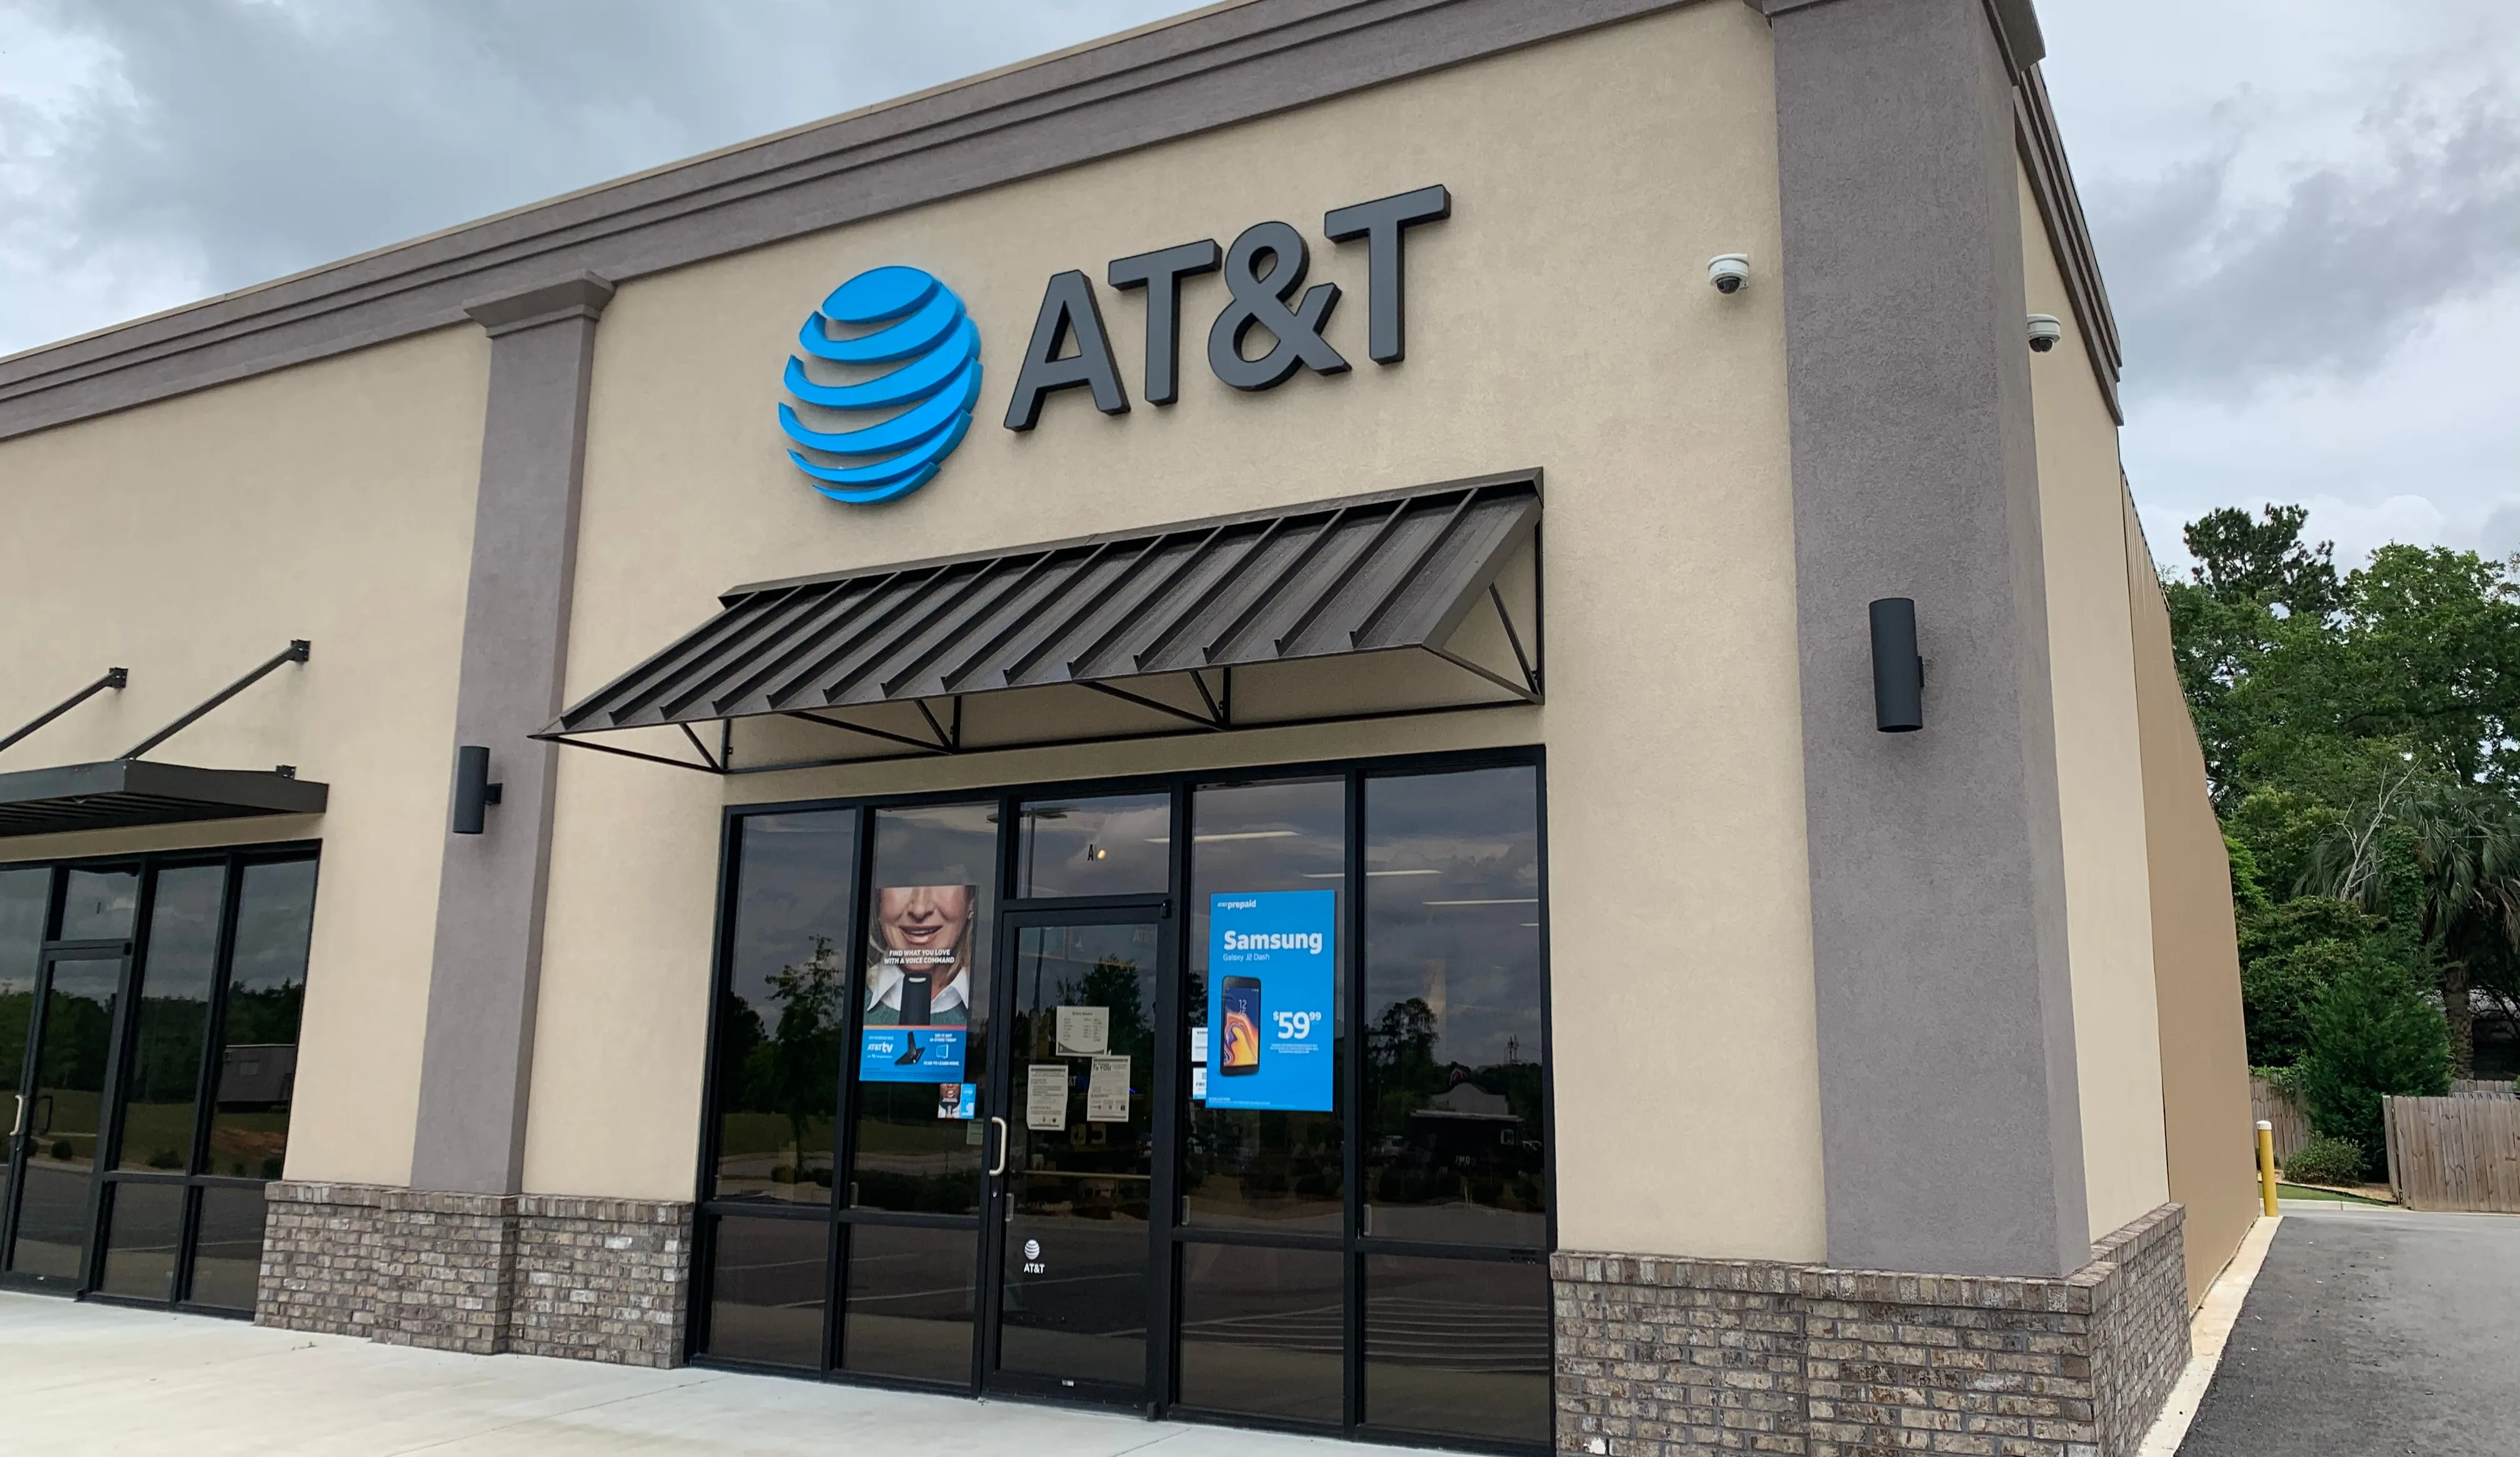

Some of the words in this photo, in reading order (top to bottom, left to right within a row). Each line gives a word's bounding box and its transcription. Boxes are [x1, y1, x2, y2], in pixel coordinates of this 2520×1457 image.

[1003, 184, 1452, 433] AT&T
[1087, 844, 1094, 861] A
[1224, 929, 1322, 954] Samsung
[1223, 953, 1244, 962] Galaxy
[1023, 1262, 1045, 1274] AT&T
